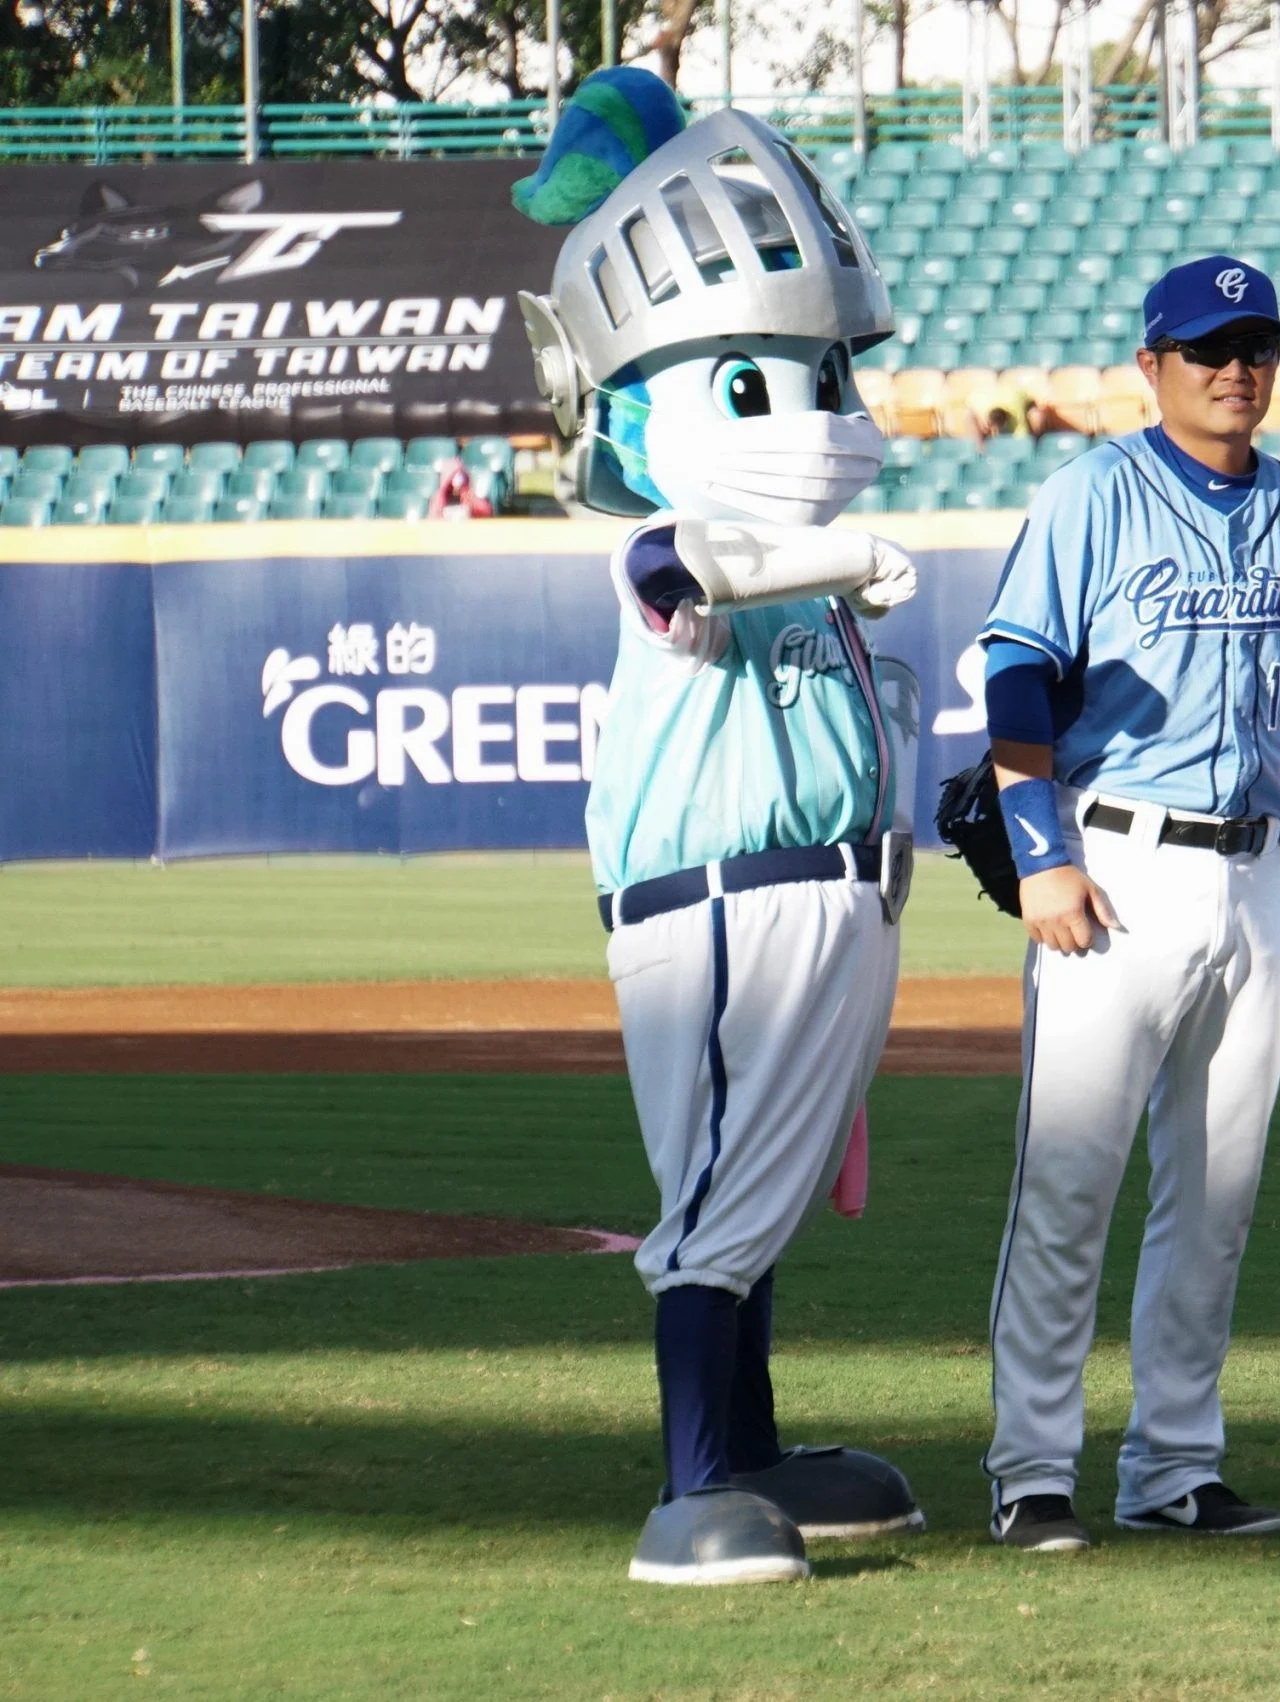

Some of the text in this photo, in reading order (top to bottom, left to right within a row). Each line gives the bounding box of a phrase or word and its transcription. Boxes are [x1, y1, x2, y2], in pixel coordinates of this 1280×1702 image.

[149, 298, 506, 341] TAIWAN
[161, 349, 239, 379] OF
[254, 344, 491, 377] TAIWAN
[118, 395, 292, 412] BASEBALL LEAGUE
[120, 377, 392, 399] THE CHINESE PROFESSIONAL
[328, 622, 437, 675] 綠的
